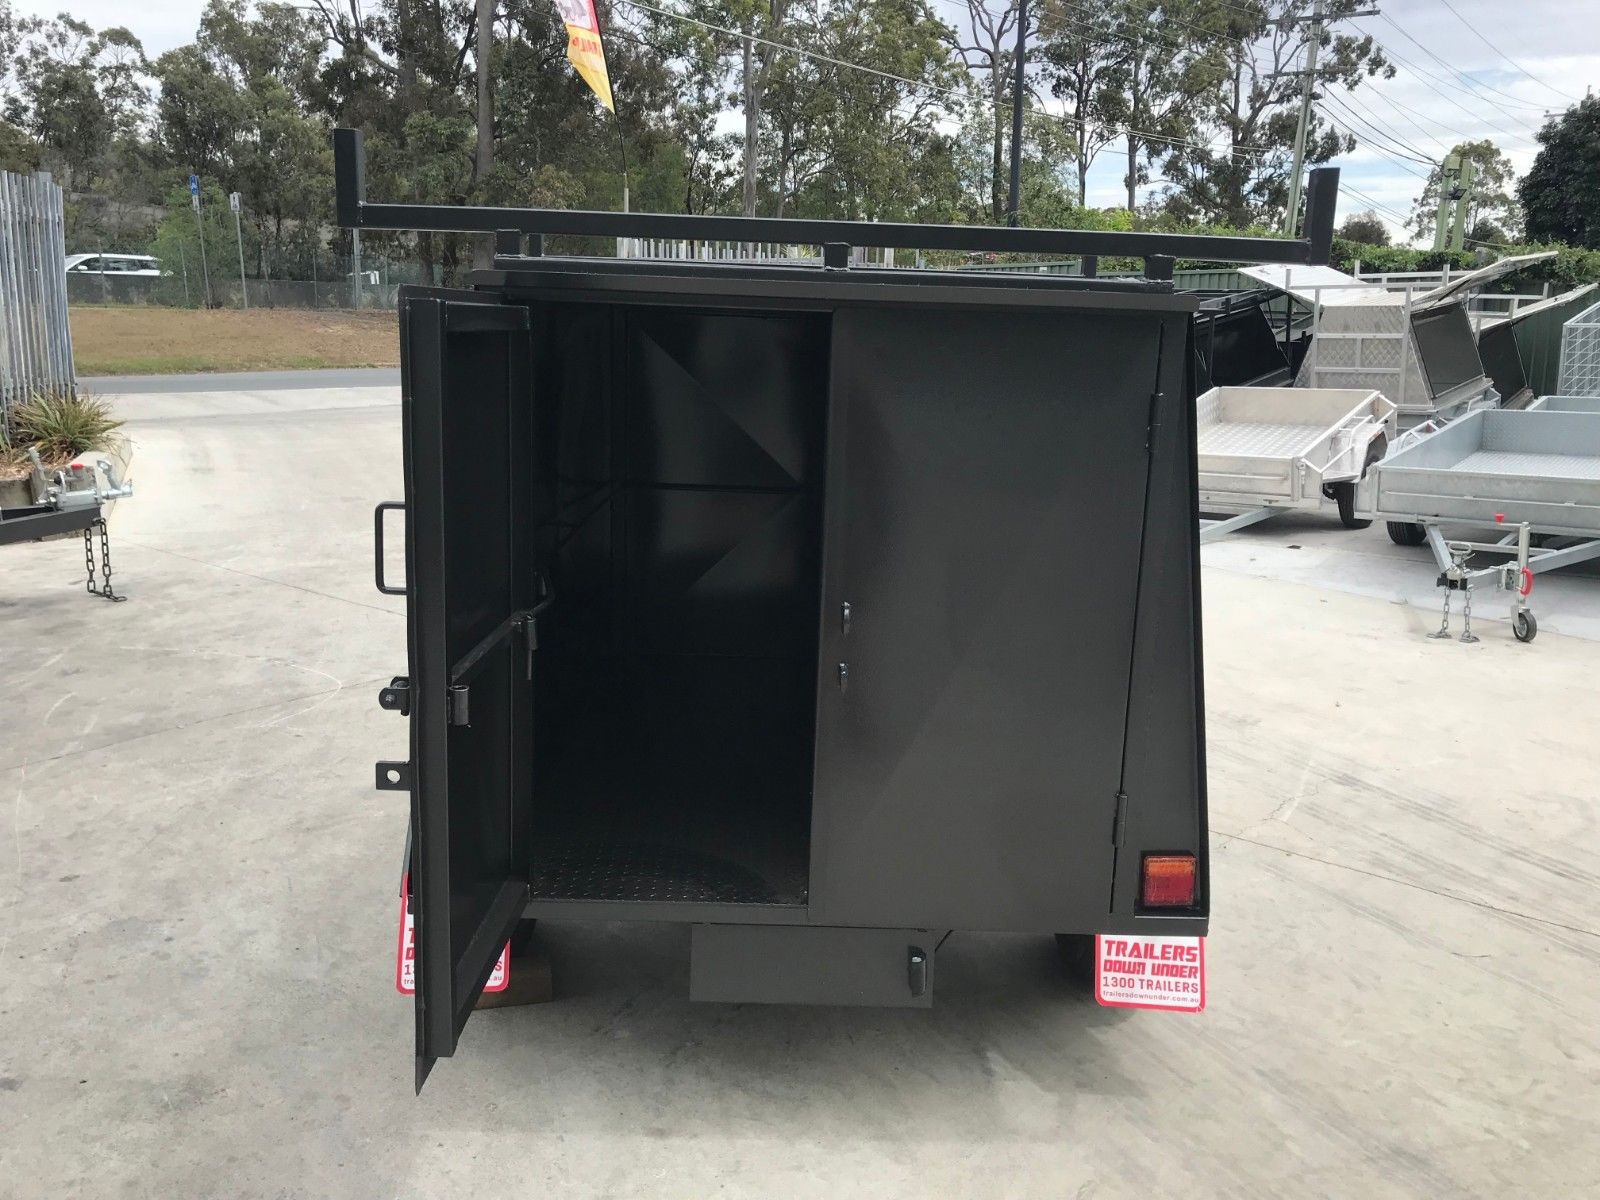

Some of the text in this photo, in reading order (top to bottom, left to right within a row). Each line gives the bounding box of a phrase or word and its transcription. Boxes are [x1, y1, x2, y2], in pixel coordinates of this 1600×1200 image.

[1105, 940, 1198, 962] TRAILERS
[1104, 960, 1198, 979] DOWN UNDER
[1103, 976, 1199, 993] 1300 TRAILERS
[1103, 991, 1199, 1003] trailersdownunder.com.au
